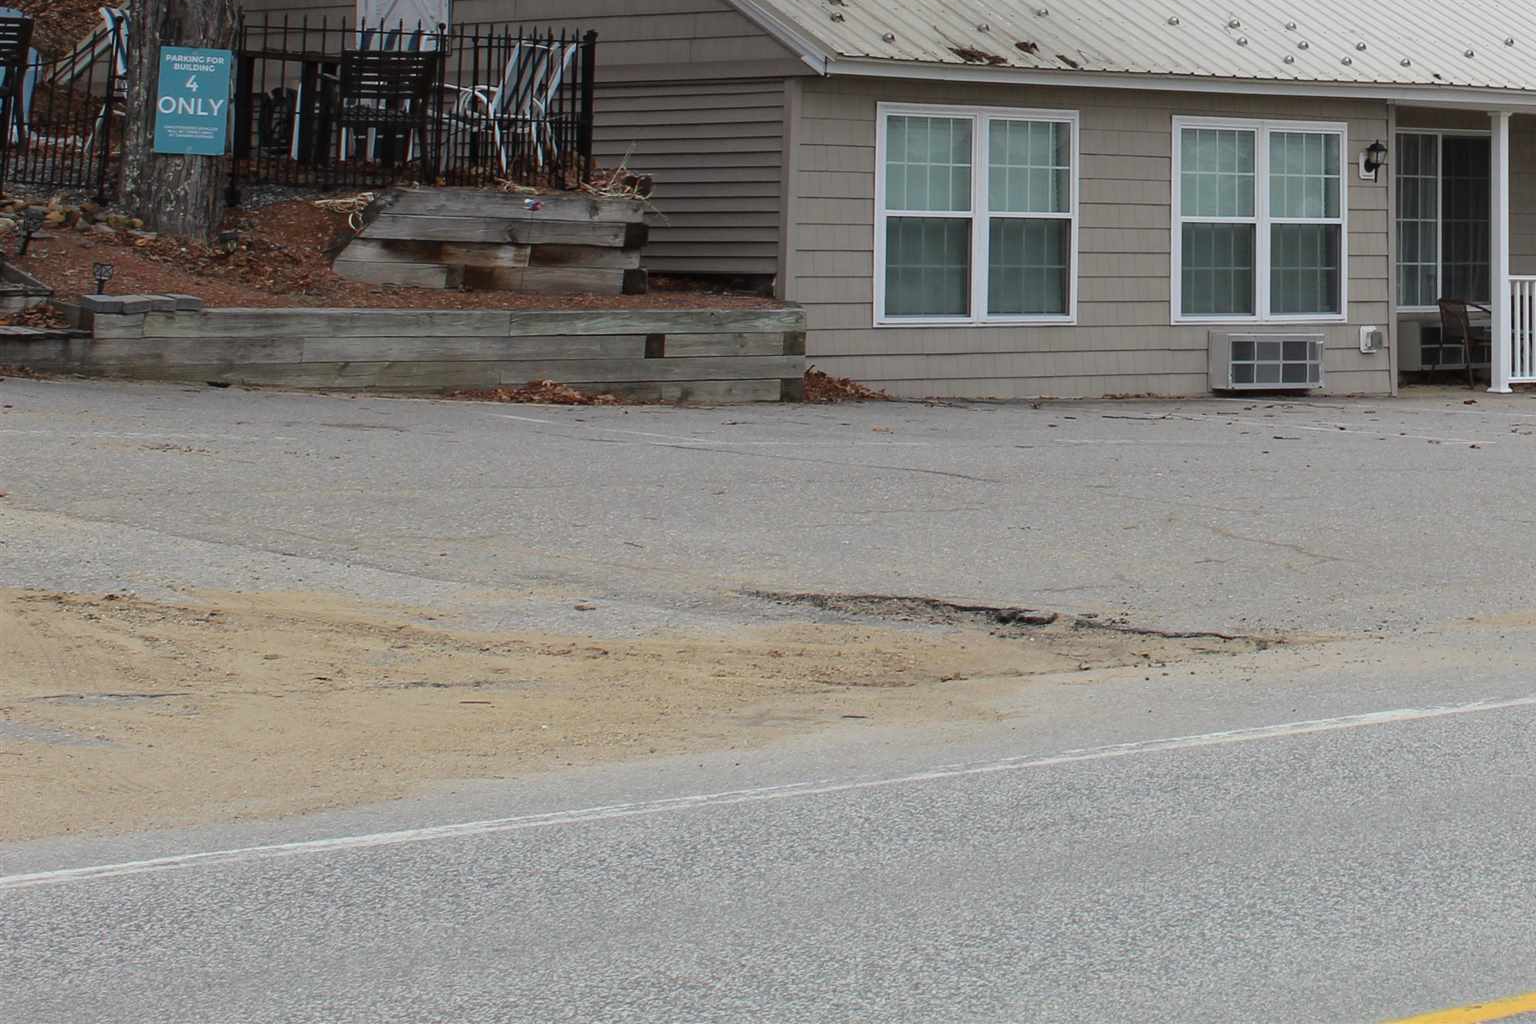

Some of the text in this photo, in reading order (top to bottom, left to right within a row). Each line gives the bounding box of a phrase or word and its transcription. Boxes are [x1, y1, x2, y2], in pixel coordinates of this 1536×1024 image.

[166, 54, 224, 64] PARKING FOR
[174, 63, 216, 72] BUILDING
[185, 74, 199, 93] 4
[159, 96, 224, 116] ONLY
